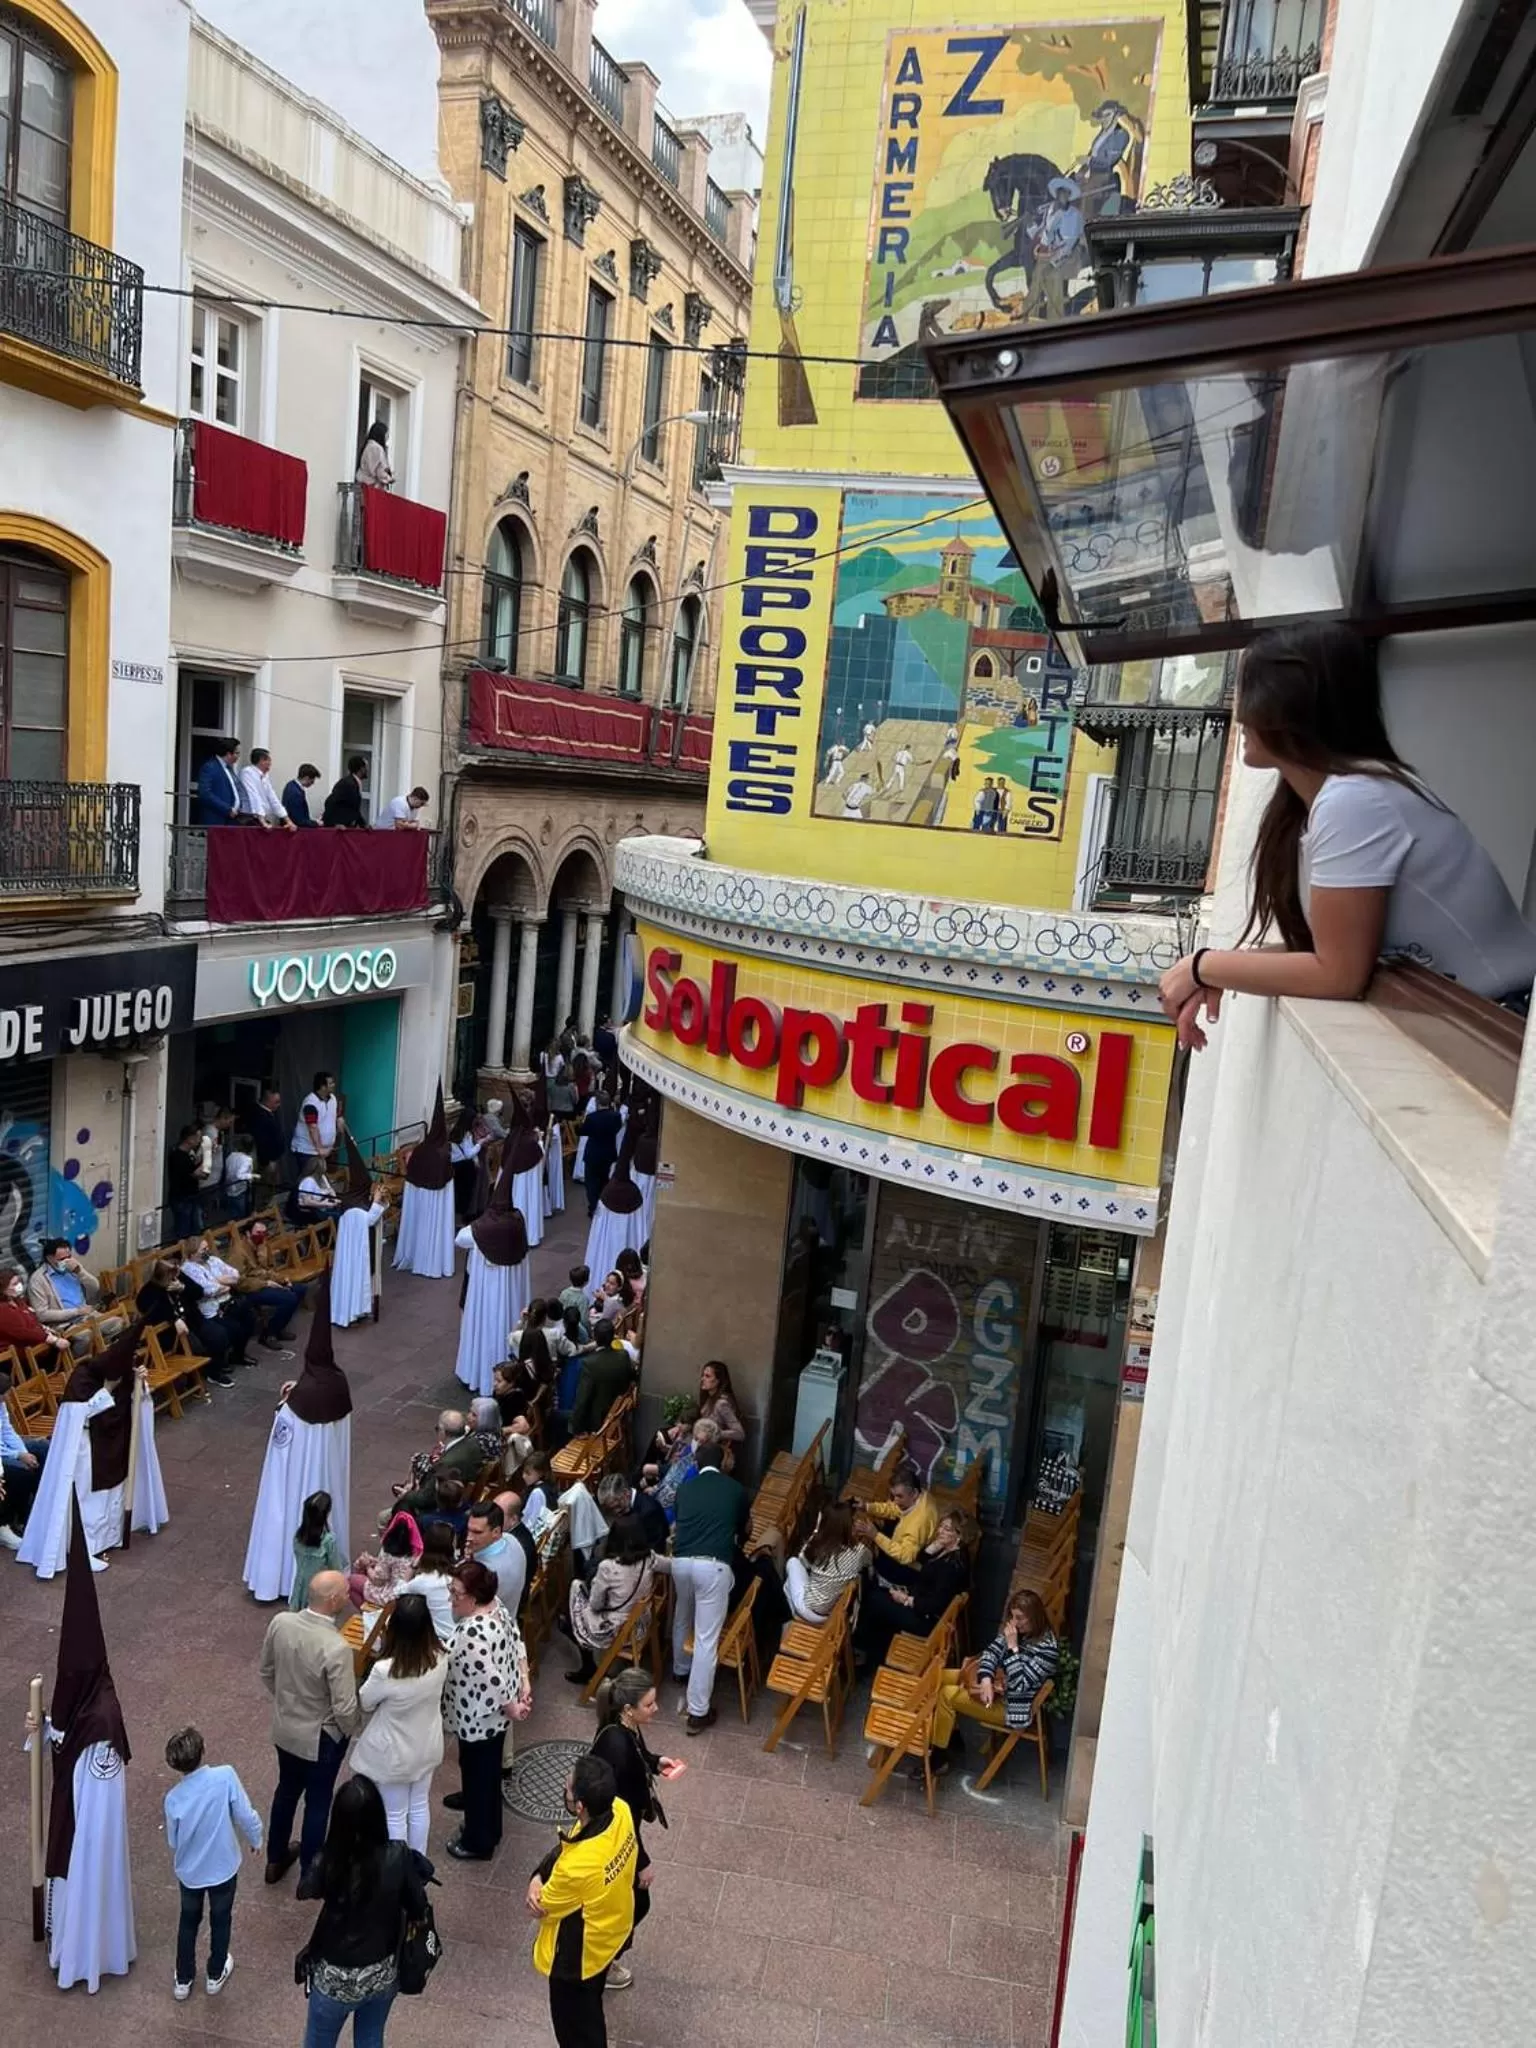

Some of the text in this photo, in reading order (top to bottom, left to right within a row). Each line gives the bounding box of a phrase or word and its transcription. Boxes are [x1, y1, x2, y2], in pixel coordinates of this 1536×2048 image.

[943, 35, 1011, 117] Z
[871, 46, 924, 349] ARMERIA
[112, 661, 151, 680] SIERPES
[725, 504, 819, 815] DEPORTES
[250, 946, 397, 1007] YOYOSO
[0, 985, 173, 1060] DE JUEGO
[644, 946, 1135, 1150] Soloptical
